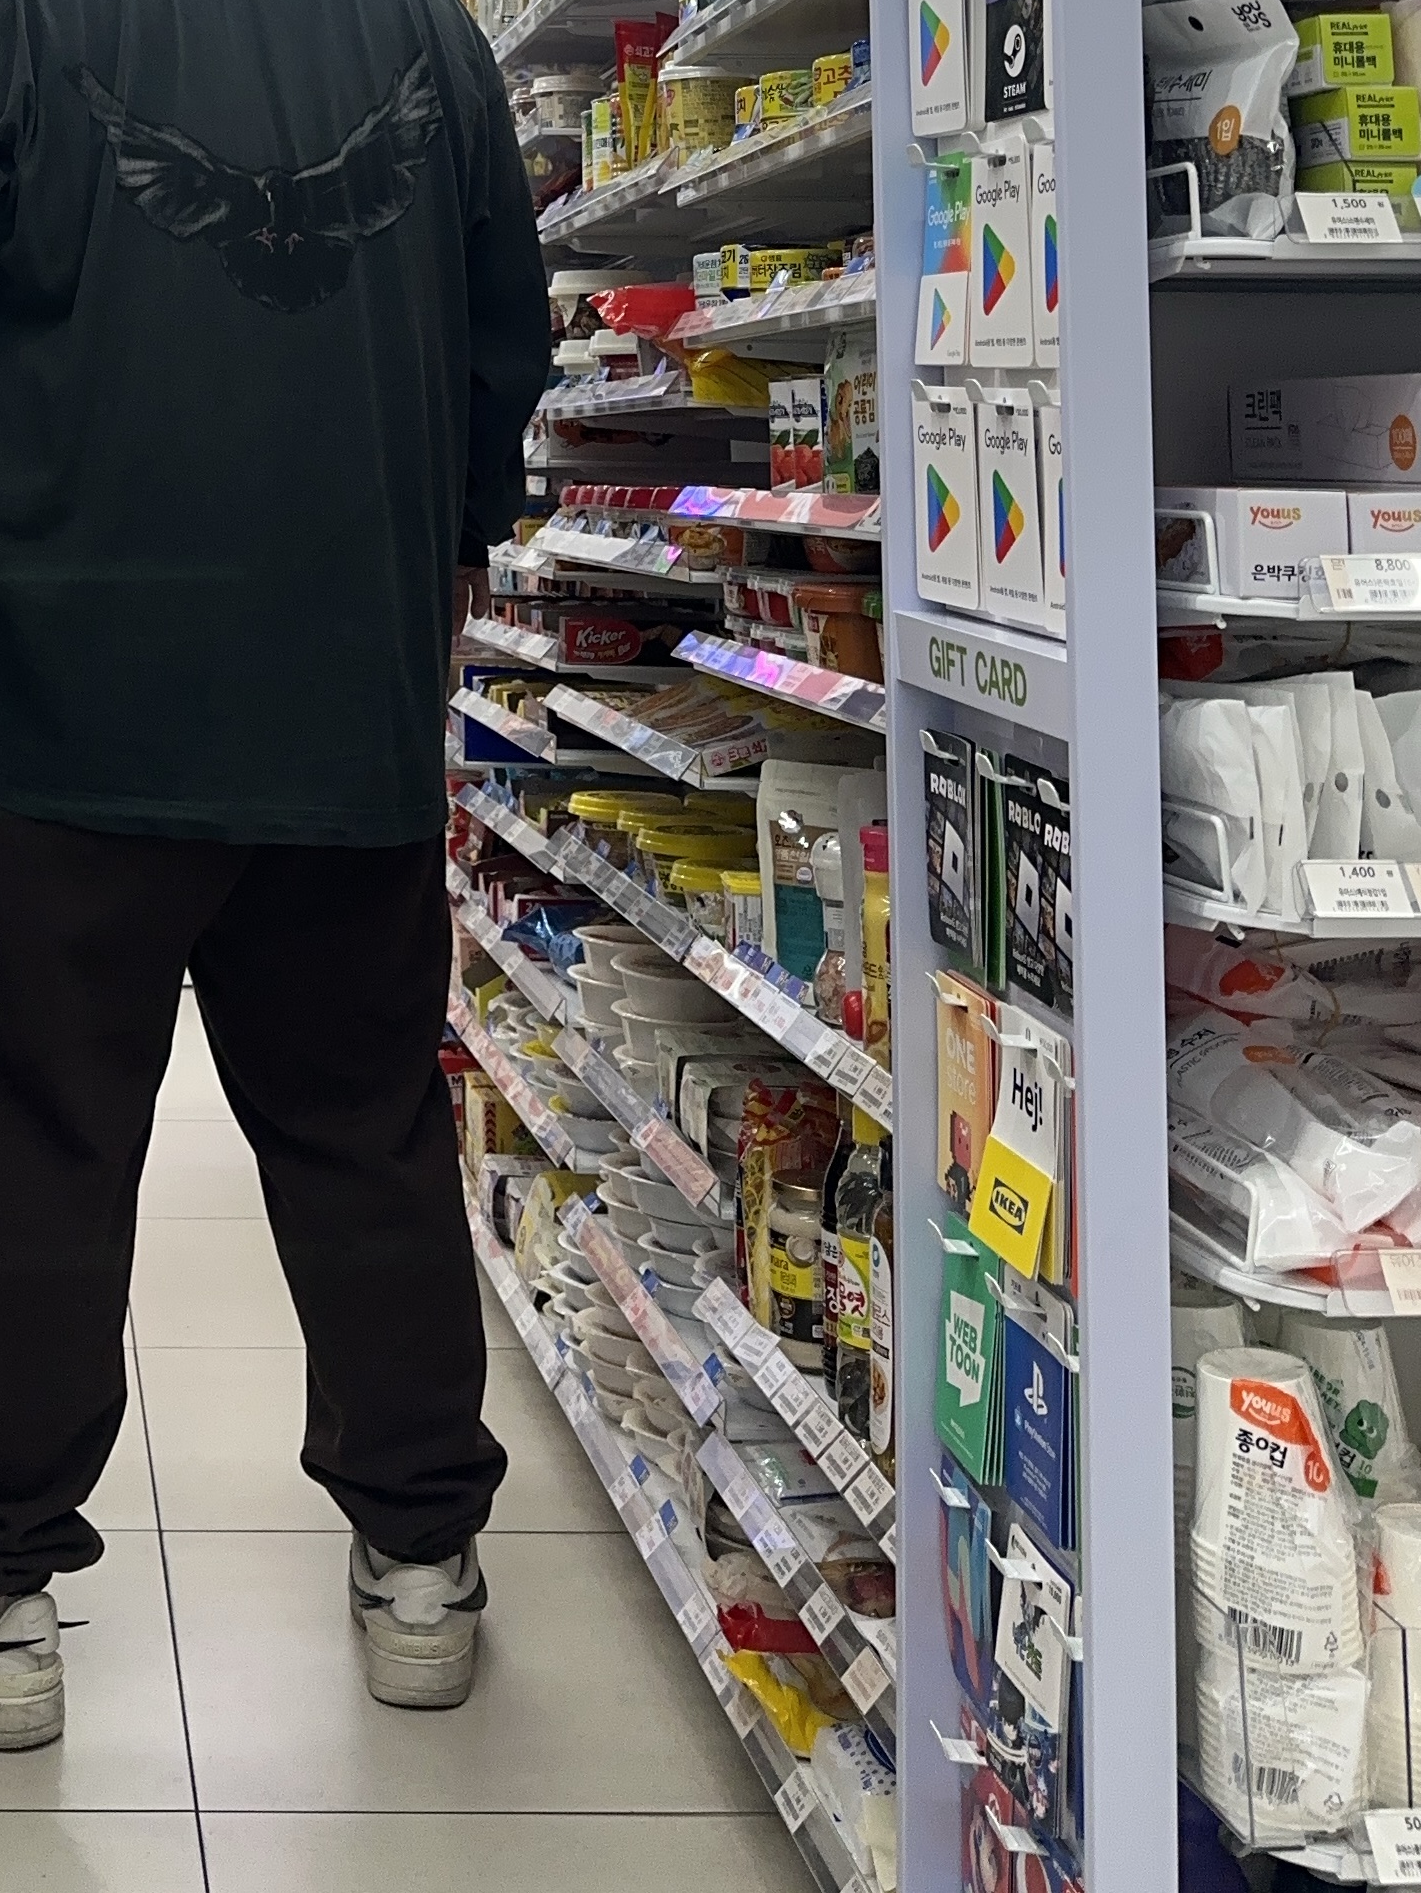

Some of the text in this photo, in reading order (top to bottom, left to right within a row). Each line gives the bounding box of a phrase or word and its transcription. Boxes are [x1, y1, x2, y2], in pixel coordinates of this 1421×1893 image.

[1330, 21, 1352, 31] REAL
[1332, 41, 1366, 55] 휴대용
[1002, 81, 1028, 99] STEAM
[1356, 94, 1377, 104] REAL
[1216, 117, 1234, 142] 1입
[1358, 112, 1392, 127] 휴대용
[1354, 166, 1376, 177] REAL
[975, 180, 1021, 208] Google Play
[1331, 197, 1368, 211] 1,500
[927, 200, 970, 229] Google Play
[917, 425, 967, 452] Google Play
[984, 428, 1028, 456] Google Play
[1249, 505, 1302, 526] youus
[1374, 558, 1411, 572] 8,800
[575, 625, 626, 648] Kicker
[928, 634, 1028, 707] GIFT CARD
[1339, 866, 1376, 879] 1,400
[945, 1026, 977, 1076] ONE
[945, 1063, 977, 1106] store
[1011, 1067, 1044, 1133] Hej!
[993, 1189, 1026, 1223] IKEA
[952, 1312, 979, 1355] WEB
[948, 1333, 981, 1384] TOON
[1241, 1389, 1293, 1424] youus
